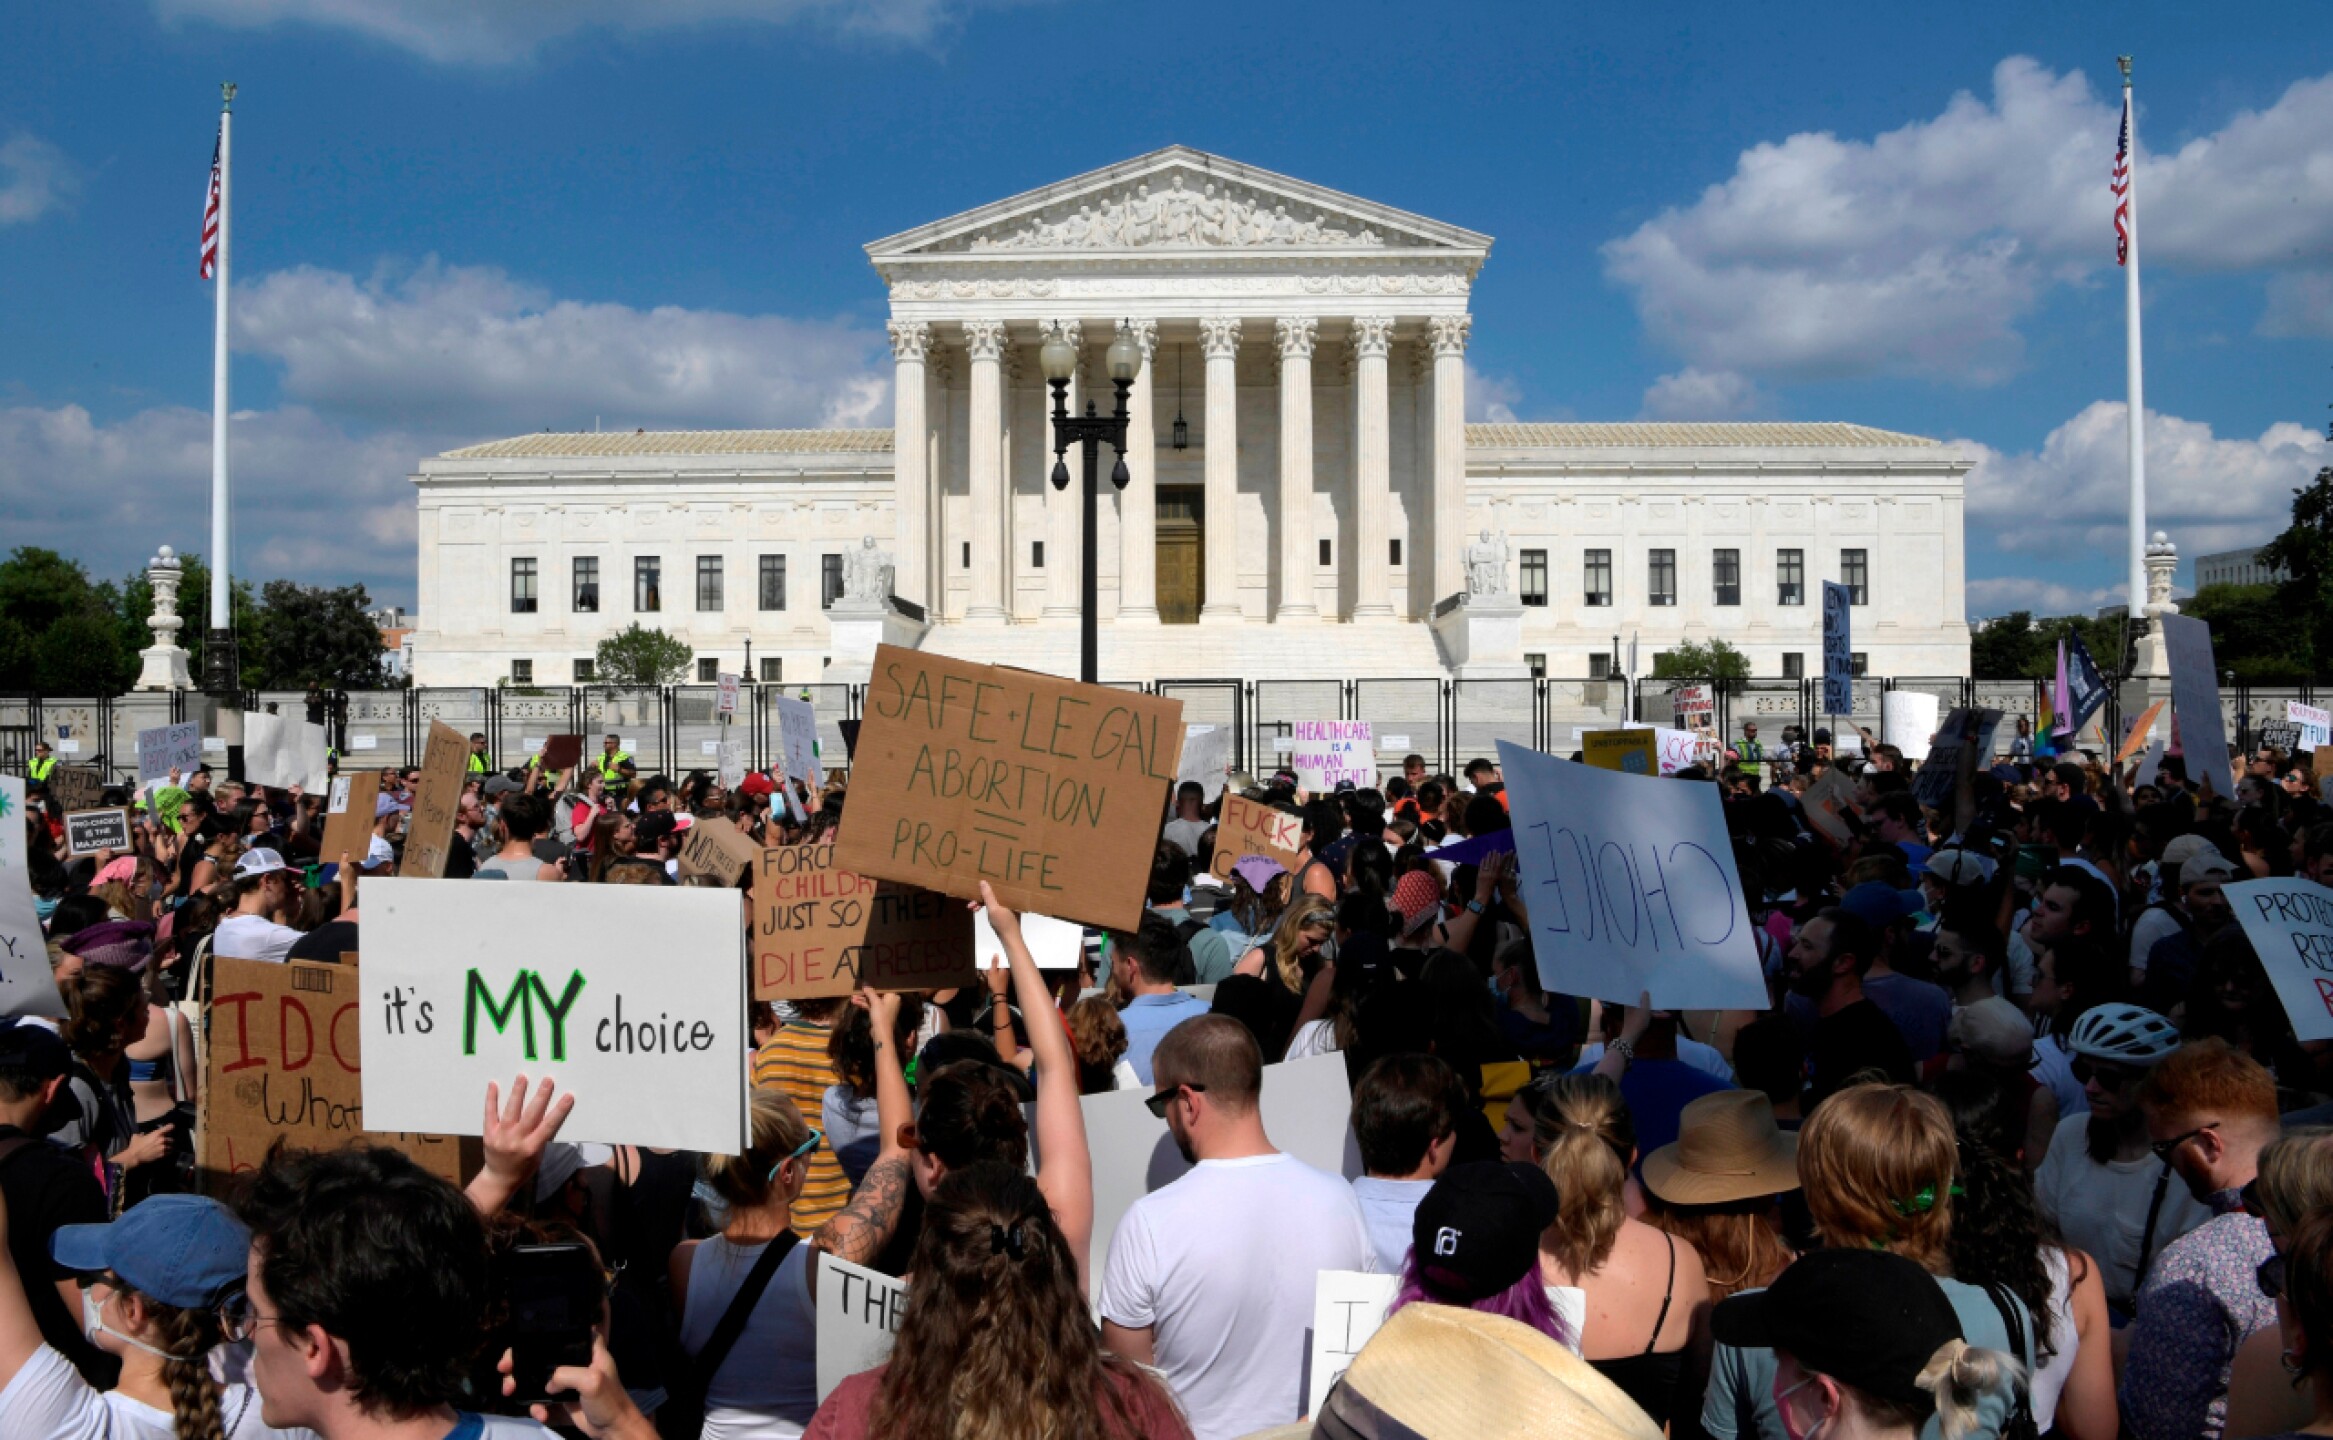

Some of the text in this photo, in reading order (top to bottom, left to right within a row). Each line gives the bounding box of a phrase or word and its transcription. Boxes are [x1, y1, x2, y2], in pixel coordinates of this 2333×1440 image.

[1196, 278, 1249, 290] UNDER
[1254, 278, 1284, 289] LAW
[877, 663, 1005, 744] SAFE
[1019, 691, 1170, 780] LEGAL
[1295, 721, 1371, 741] HEALTHCARE
[143, 747, 168, 774] MY
[1295, 753, 1343, 770] HUMAN
[1331, 741, 1353, 752] IS A
[907, 743, 1105, 829] ABORTION
[1324, 768, 1368, 786] RIGHT
[1227, 800, 1299, 849] FUCK
[684, 830, 714, 868] NO
[892, 817, 1064, 891] PRO-LIFE
[762, 901, 820, 936] JUST
[827, 900, 863, 929] SO
[760, 936, 967, 989] DIE AT RECESS
[383, 967, 716, 1062] it's MY choice
